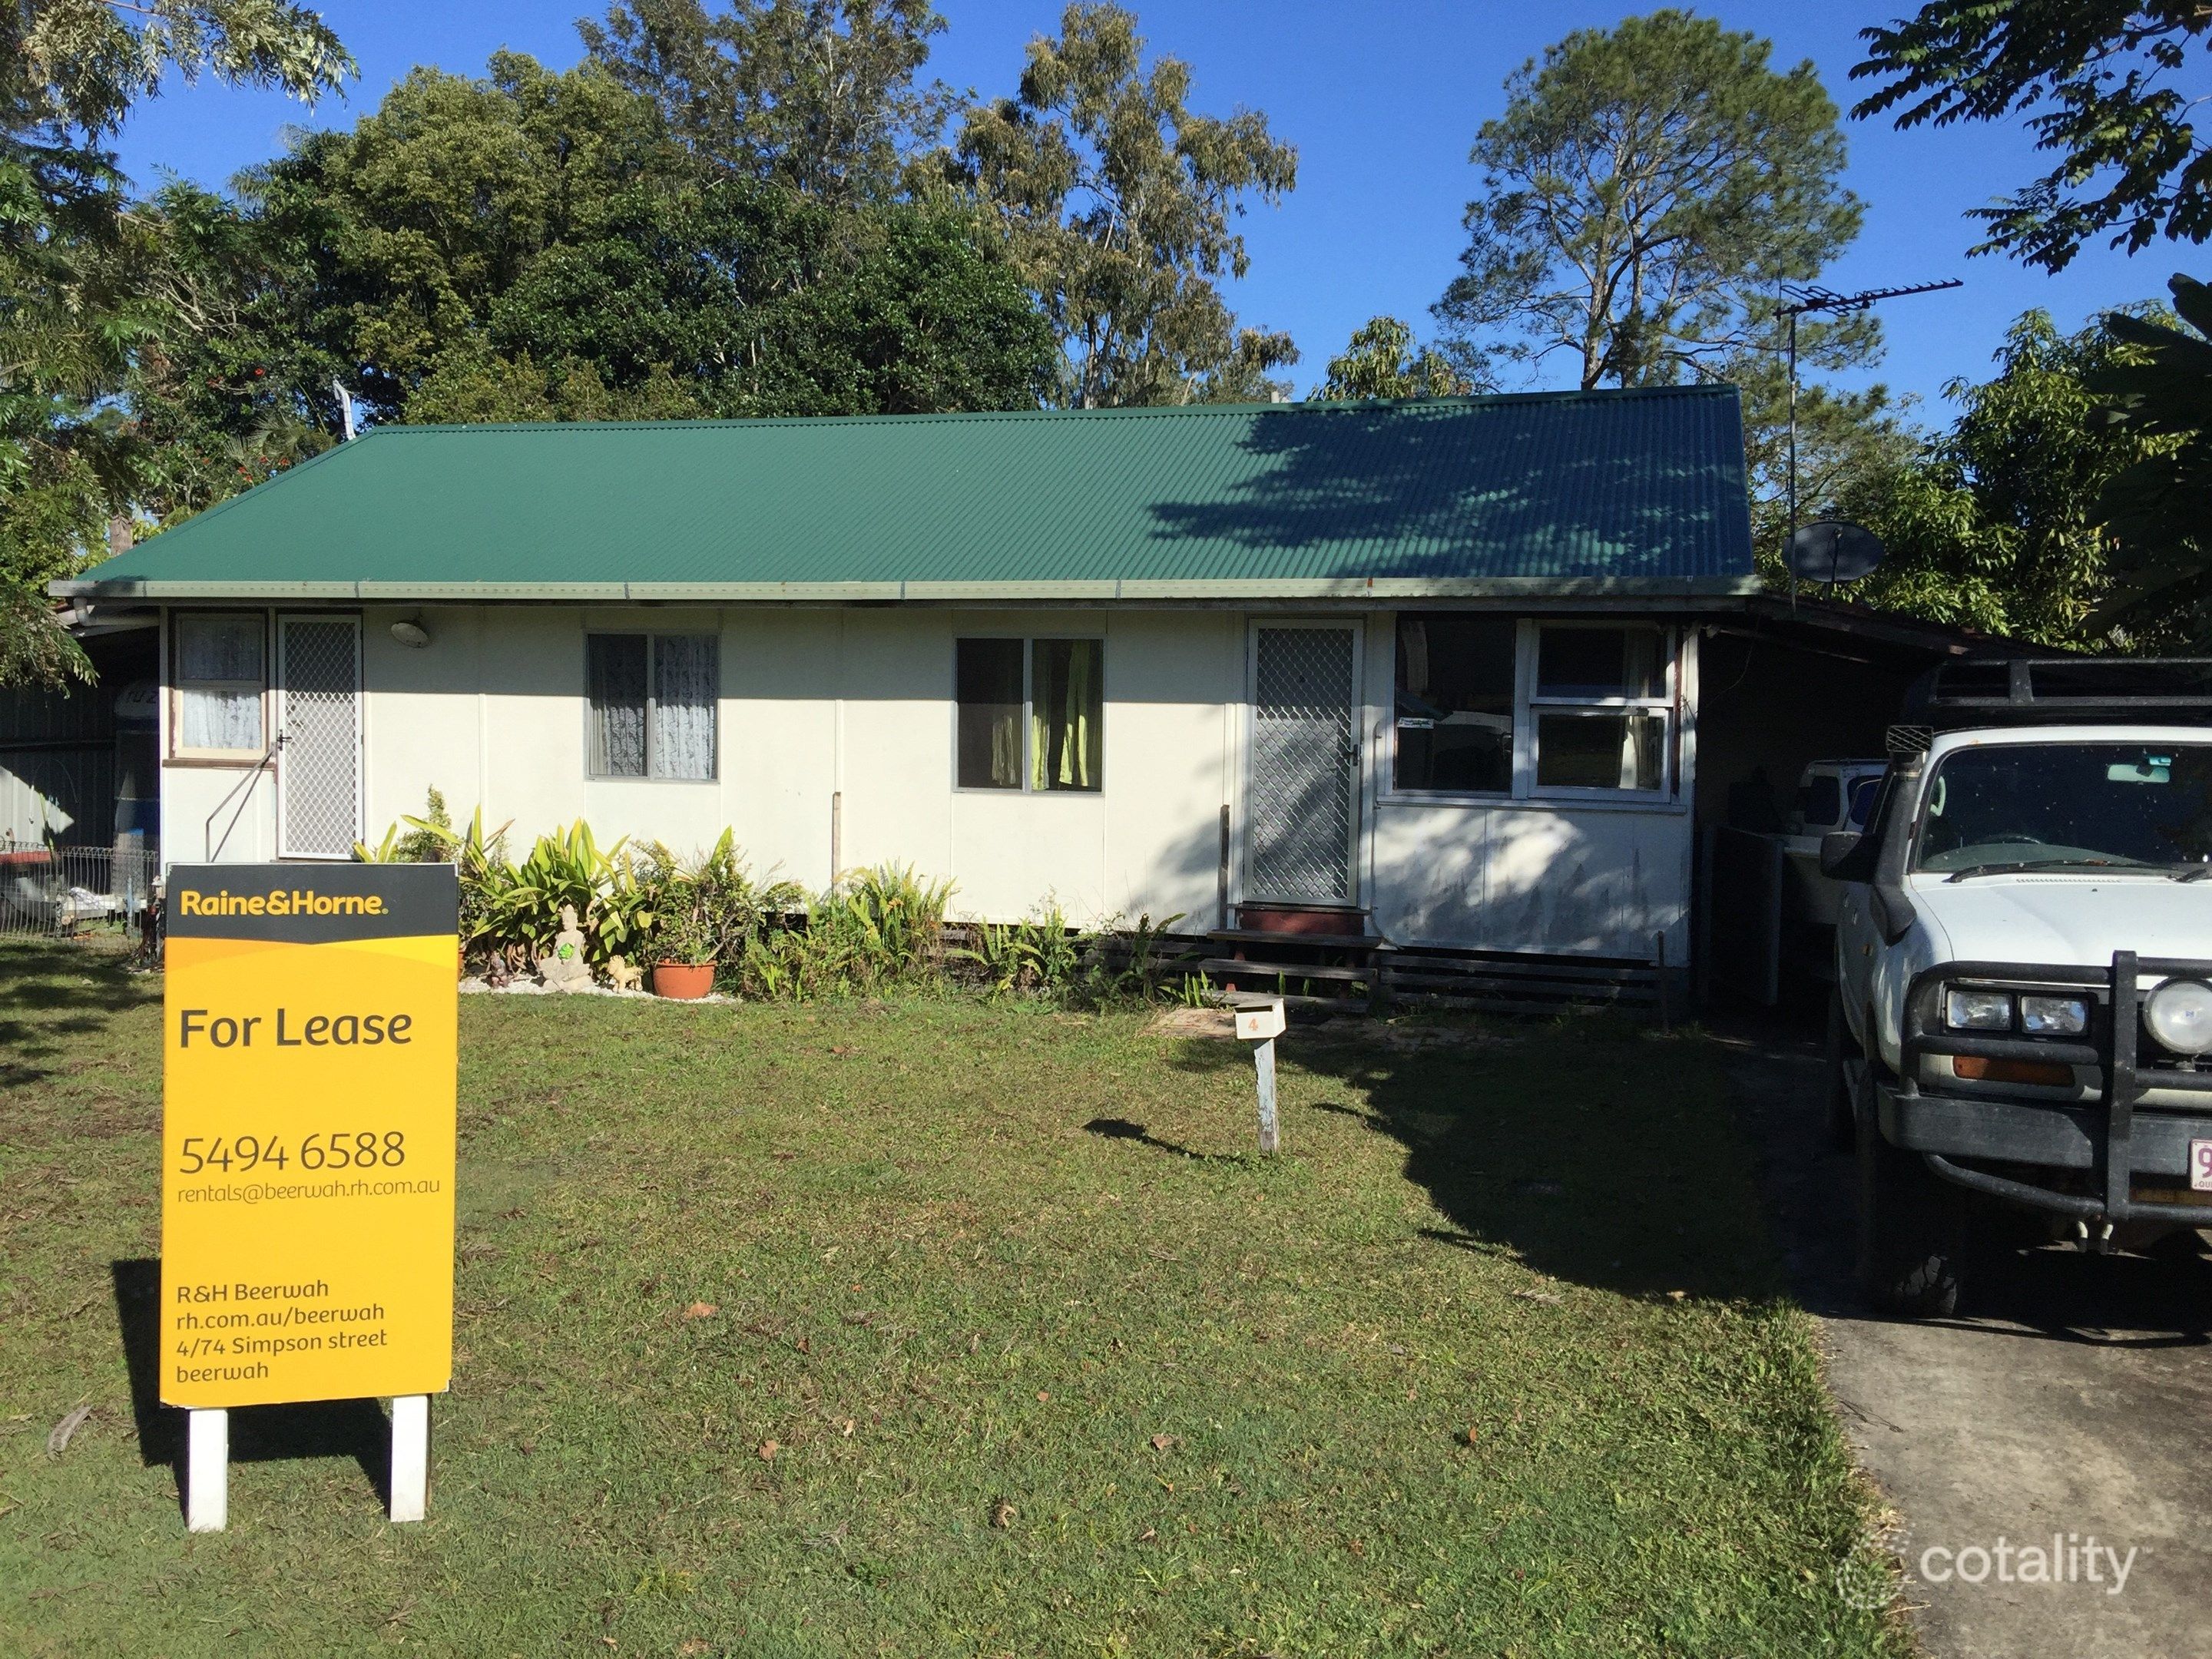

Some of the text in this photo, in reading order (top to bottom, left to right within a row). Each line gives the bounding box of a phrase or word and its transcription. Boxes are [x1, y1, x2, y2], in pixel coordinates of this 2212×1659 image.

[180, 1008, 412, 1048] For Lease
[1248, 1017, 1259, 1031] 4
[180, 1131, 406, 1174] 5494 6588
[177, 1179, 440, 1204] rentals@beerwah.rh.com.au
[177, 1280, 329, 1303] R&H Beerwah
[177, 1303, 384, 1330] rh.com.au/beerwah
[176, 1329, 388, 1359] 4/74 Simpson street
[176, 1362, 269, 1383] beerwah
